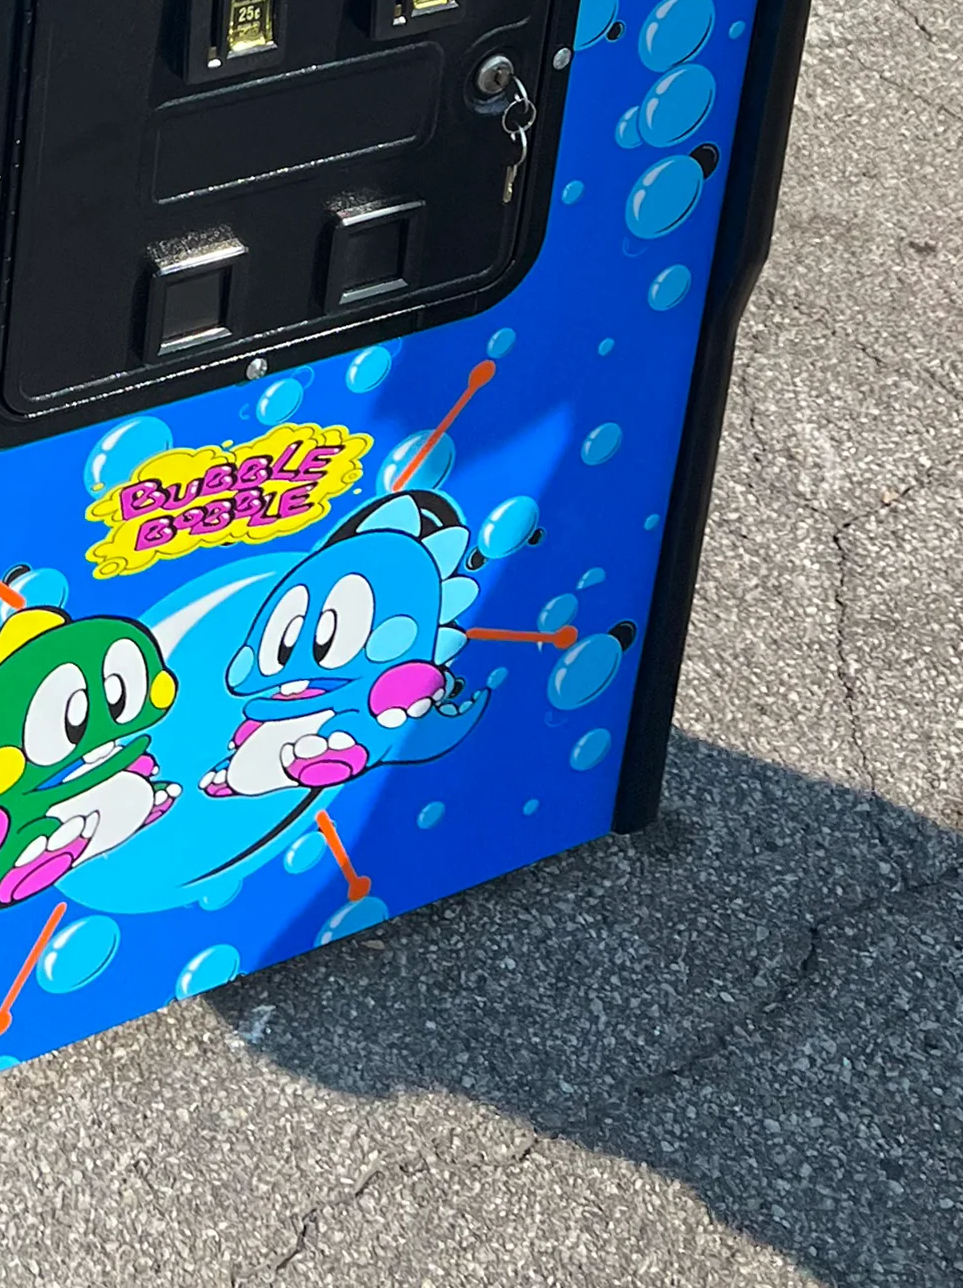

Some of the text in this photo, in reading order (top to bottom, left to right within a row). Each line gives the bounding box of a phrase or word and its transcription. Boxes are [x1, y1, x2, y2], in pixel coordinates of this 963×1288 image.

[238, 5, 261, 22] 25¢
[120, 439, 347, 522] BUBBLE
[134, 481, 319, 551] BOBBLE
